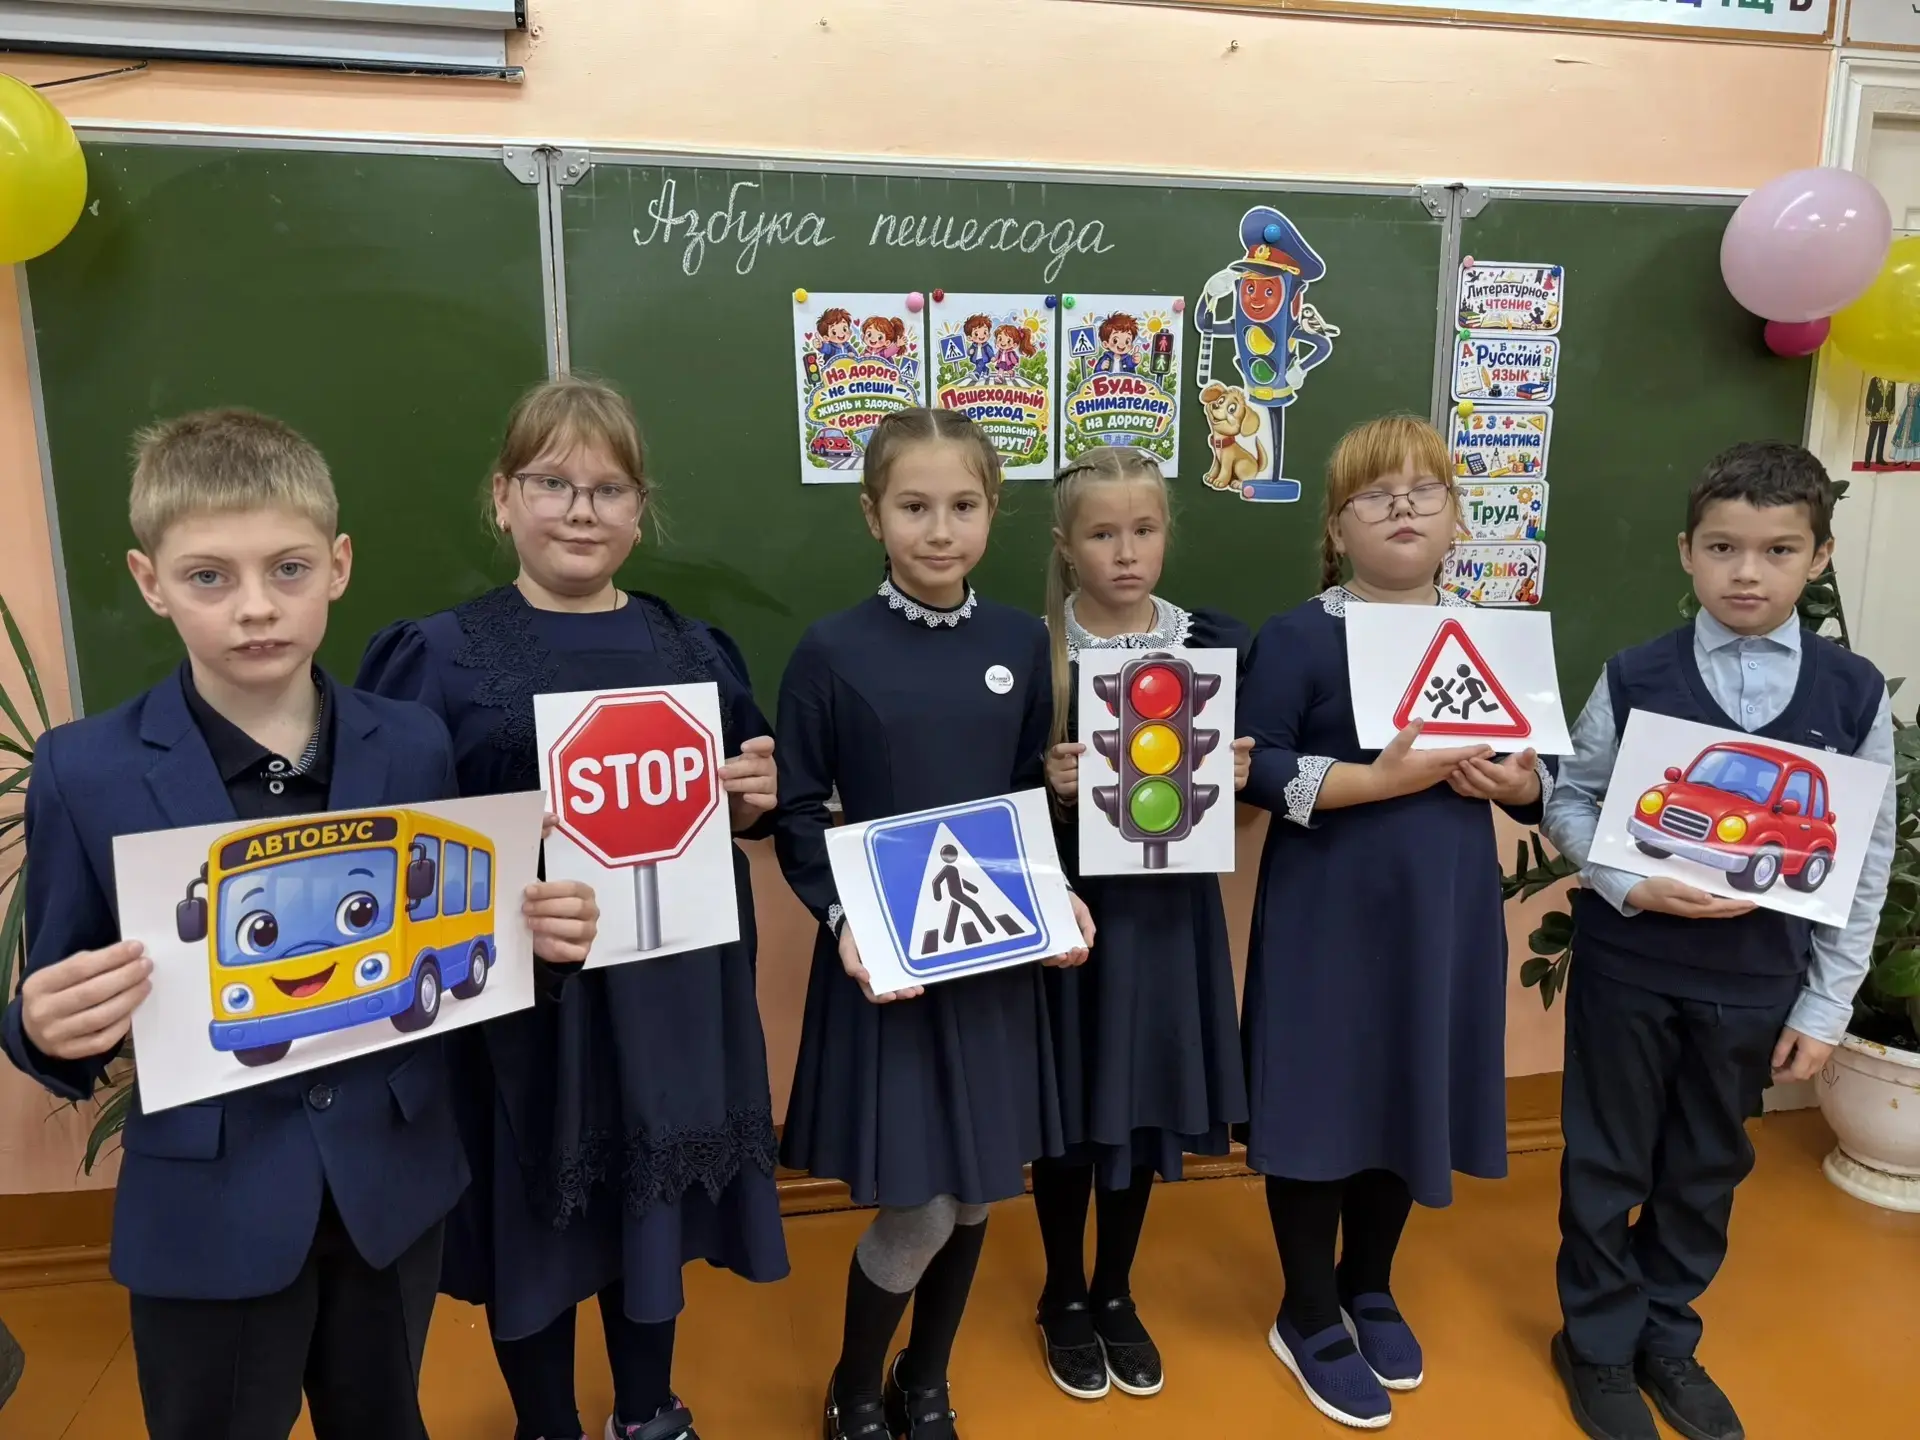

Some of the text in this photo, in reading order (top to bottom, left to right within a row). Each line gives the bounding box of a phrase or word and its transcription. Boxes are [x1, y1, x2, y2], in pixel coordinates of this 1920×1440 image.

[633, 178, 1116, 284] Азбука пешехода
[1467, 284, 1549, 300] Литературное
[1485, 299, 1533, 311] чтение
[1476, 344, 1542, 368] Русский
[825, 364, 898, 385] На дороге
[1491, 368, 1530, 382] язык
[828, 385, 846, 399] не
[848, 380, 894, 395] спеши
[1092, 376, 1148, 397] Будь
[817, 400, 853, 417] жизнь
[864, 399, 910, 412] здоровь
[940, 388, 1045, 410] Пешеходный
[1075, 396, 1170, 416] внимателен
[978, 423, 1038, 438] езопасный
[1086, 416, 1103, 430] на
[1456, 430, 1541, 447] Математика
[1469, 500, 1519, 525] Труд
[1455, 559, 1528, 582] Музыка
[567, 746, 705, 815] STOP
[245, 820, 375, 861] АВТОБУС
